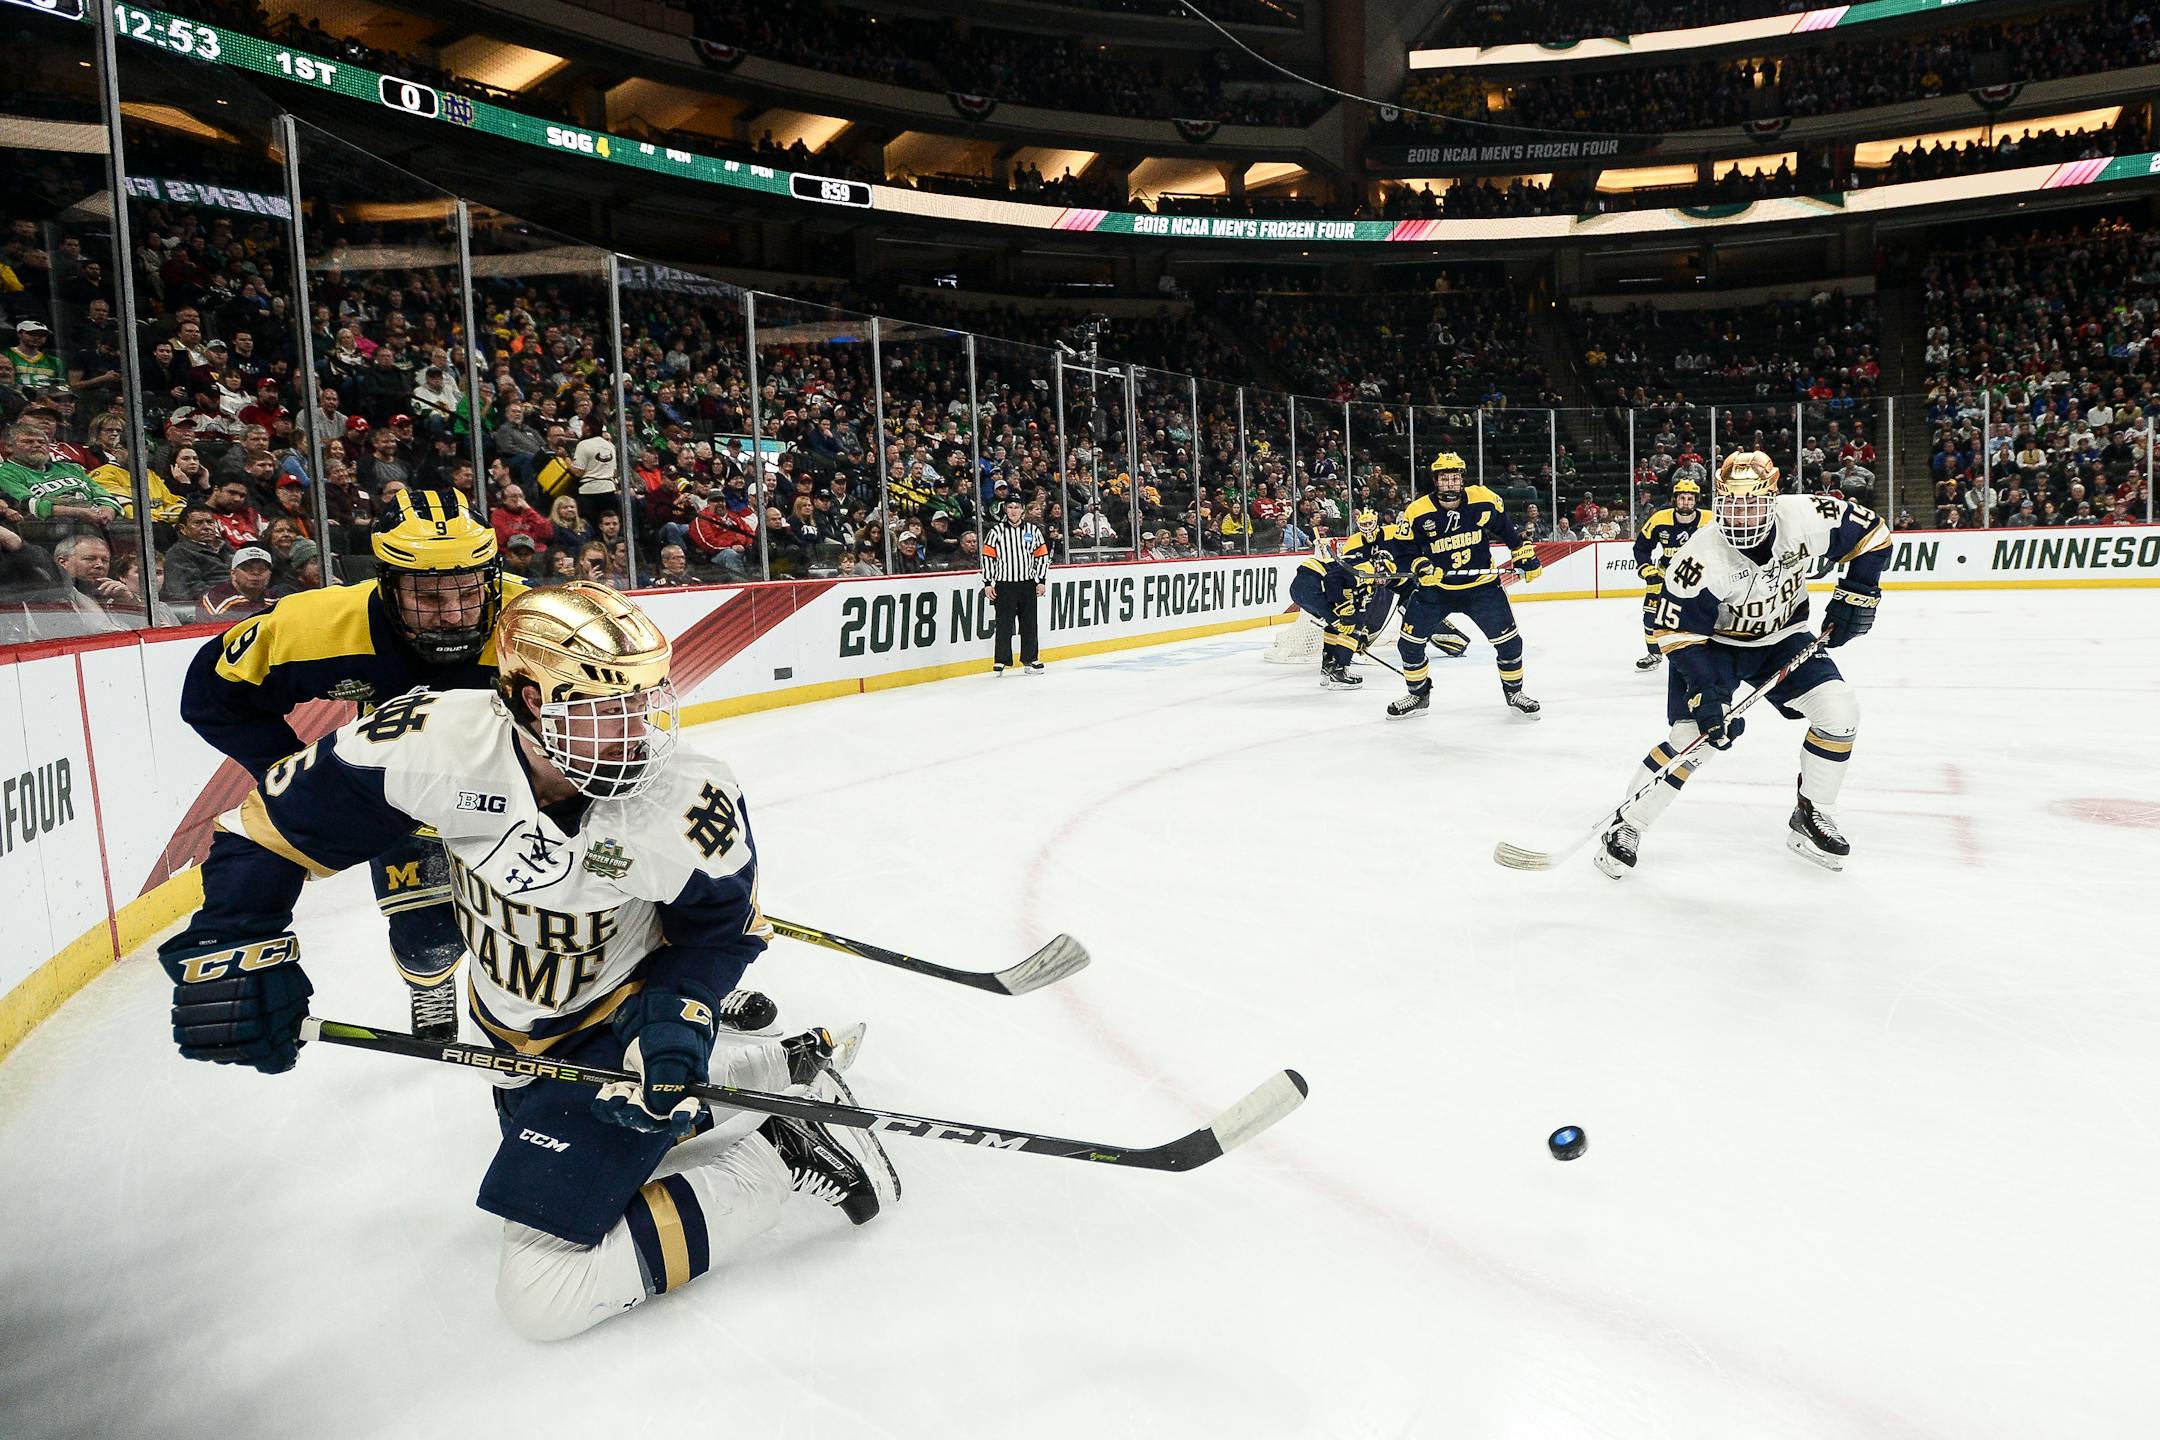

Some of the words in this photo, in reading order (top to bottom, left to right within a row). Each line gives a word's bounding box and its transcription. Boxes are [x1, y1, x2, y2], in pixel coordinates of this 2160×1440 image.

[115, 5, 221, 60] 12:53
[276, 51, 337, 86] 1ST
[401, 84, 421, 111] 0
[547, 126, 593, 153] SOG
[595, 136, 611, 157] 4
[1408, 148, 1440, 163] 2018
[1442, 146, 1477, 162] NCAA
[1480, 144, 1523, 161] MEN'S
[1526, 142, 1579, 159] FROZEN
[1582, 139, 1619, 156] FOUR
[1134, 215, 1168, 233] 2018
[1171, 217, 1209, 235] NCAA
[1212, 219, 1257, 237] MEN'S
[1260, 220, 1314, 239] FROZEN
[1317, 222, 1355, 239] FOUR
[435, 521, 447, 536] 9
[1450, 547, 1472, 569] 33
[839, 590, 937, 657] 2018
[1050, 577, 1134, 632] MEN'S
[1142, 570, 1226, 616] FROZEN
[1231, 566, 1278, 606] FOUR
[1655, 597, 1682, 629] 15
[3, 757, 74, 853] FOUR
[385, 861, 422, 891] M
[441, 1048, 579, 1082] RIBCORE
[519, 1127, 572, 1154] CCM
[867, 1114, 1031, 1152] CCM
